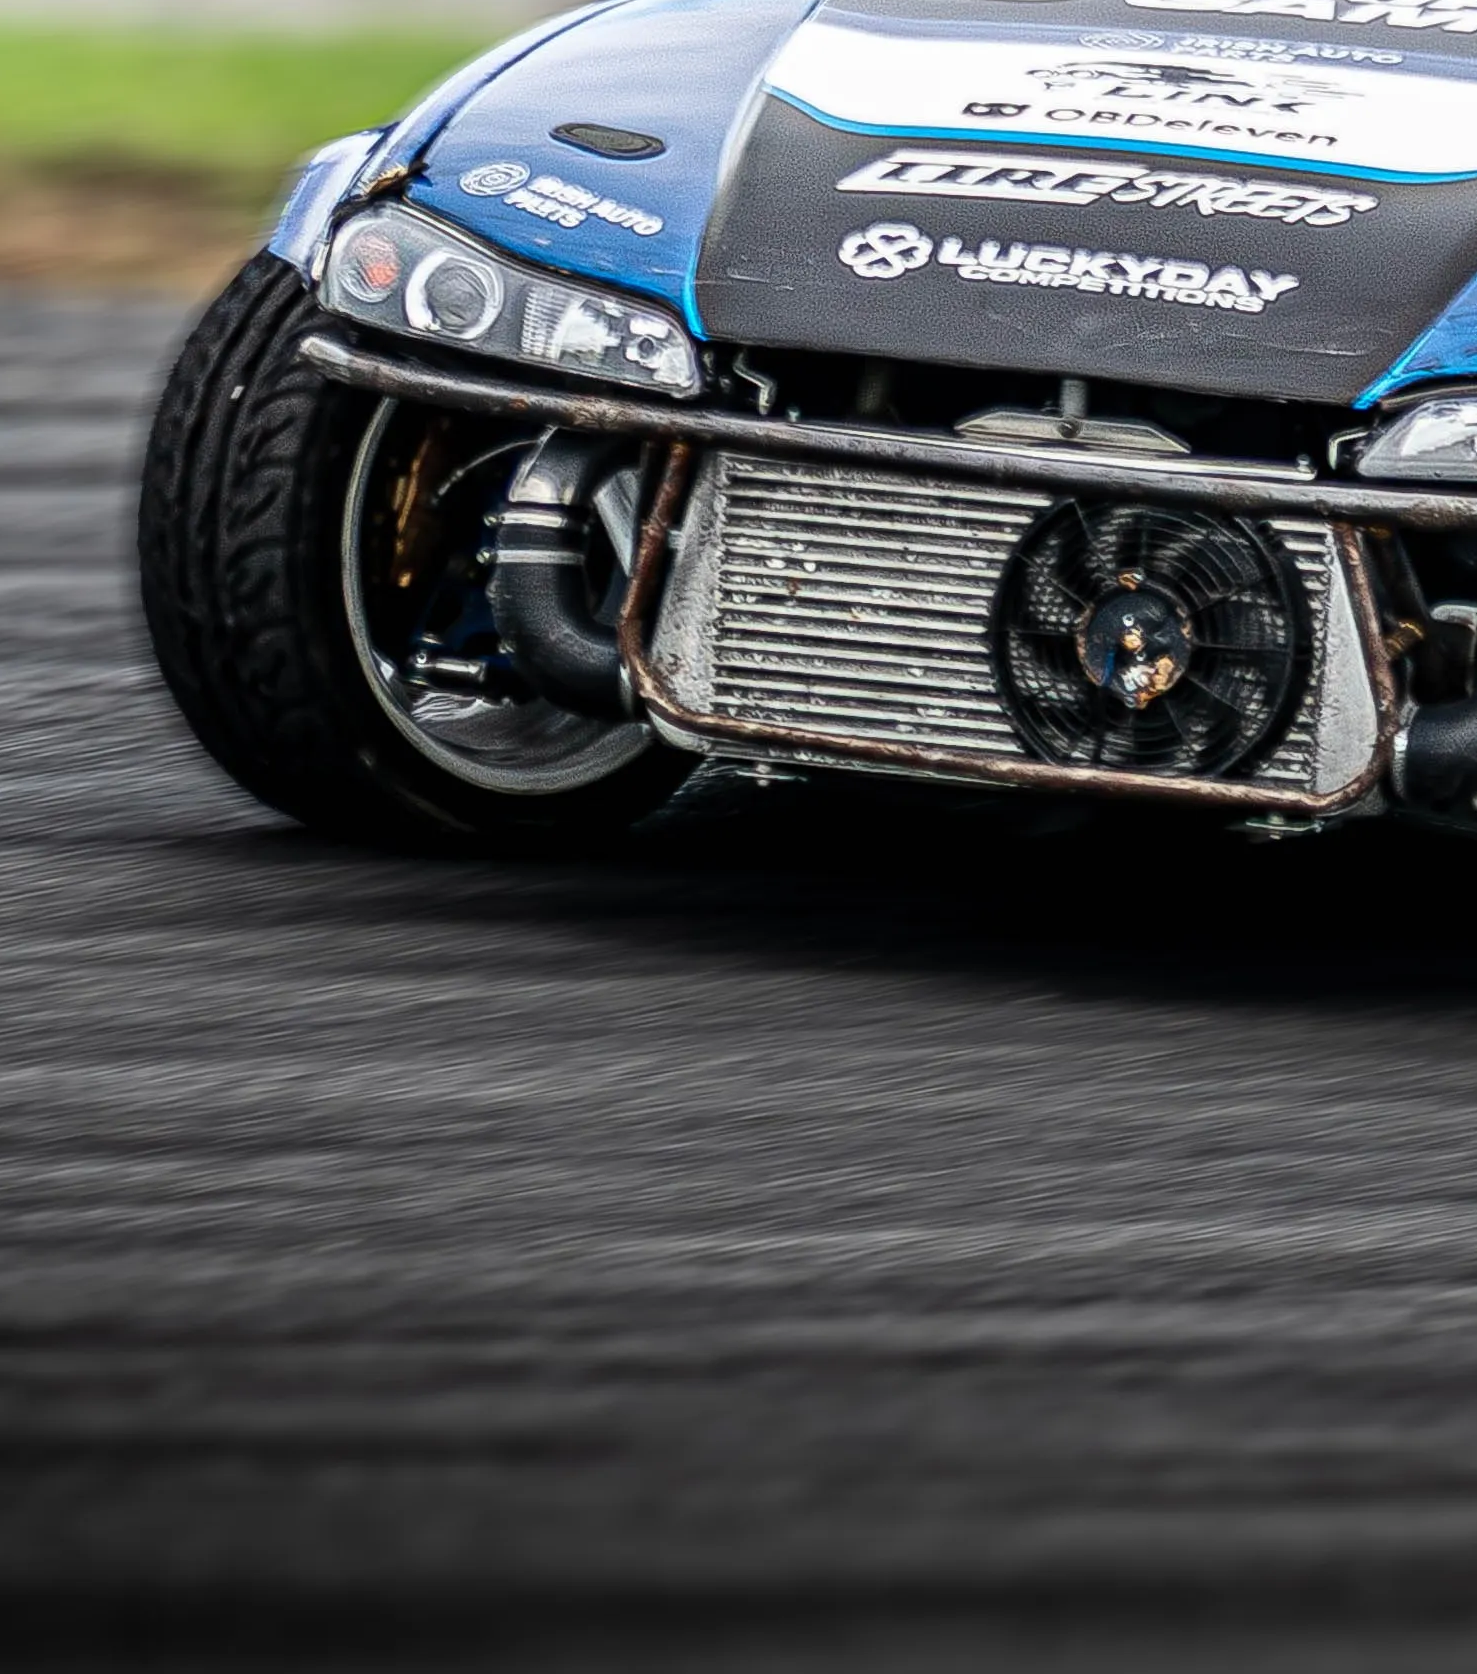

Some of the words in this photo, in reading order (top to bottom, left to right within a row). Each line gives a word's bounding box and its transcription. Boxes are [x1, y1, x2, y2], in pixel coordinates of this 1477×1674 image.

[1044, 107, 1338, 148] OBDeleven
[1110, 170, 1379, 226] STREETS
[936, 233, 1300, 303] LUCKYDAY
[956, 264, 1267, 313] COMPETITIONS
